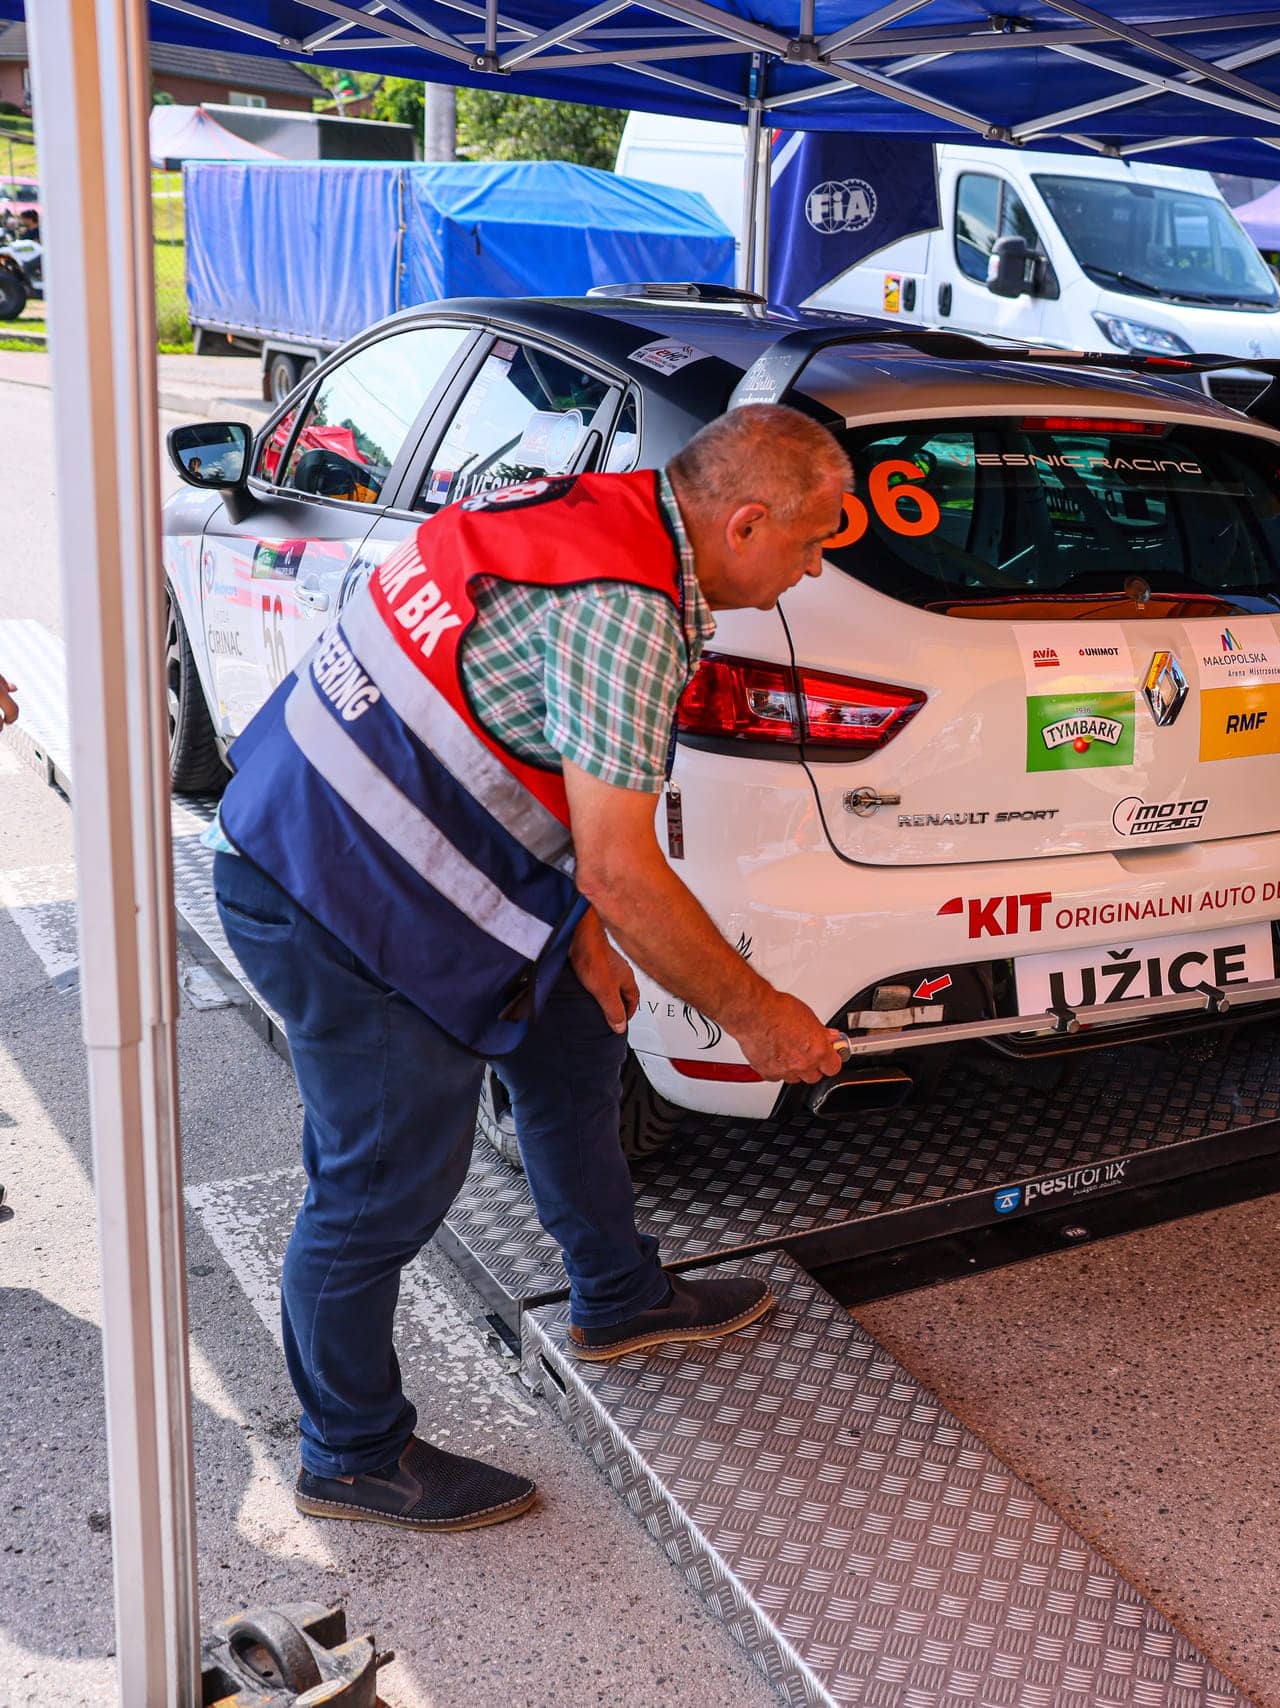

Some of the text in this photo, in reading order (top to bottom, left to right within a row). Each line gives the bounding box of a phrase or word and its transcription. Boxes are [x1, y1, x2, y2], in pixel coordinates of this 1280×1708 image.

[950, 453, 1203, 475] VESNIC RACING
[393, 579, 462, 659] BK
[1085, 648, 1119, 657] UNIMOT
[1202, 652, 1268, 667] MAŁOPOLSKA
[1046, 719, 1118, 743] TYMBARK
[1225, 711, 1268, 735] RMF
[897, 808, 1060, 828] RENAULT SPORT
[1135, 799, 1209, 822] MOTO
[1131, 816, 1202, 835] WIZJA
[967, 891, 1053, 939] KIT
[1055, 893, 1193, 930] ORIGINALNI
[1200, 884, 1257, 913] AUTO
[1048, 943, 1249, 1009] UŽICE
